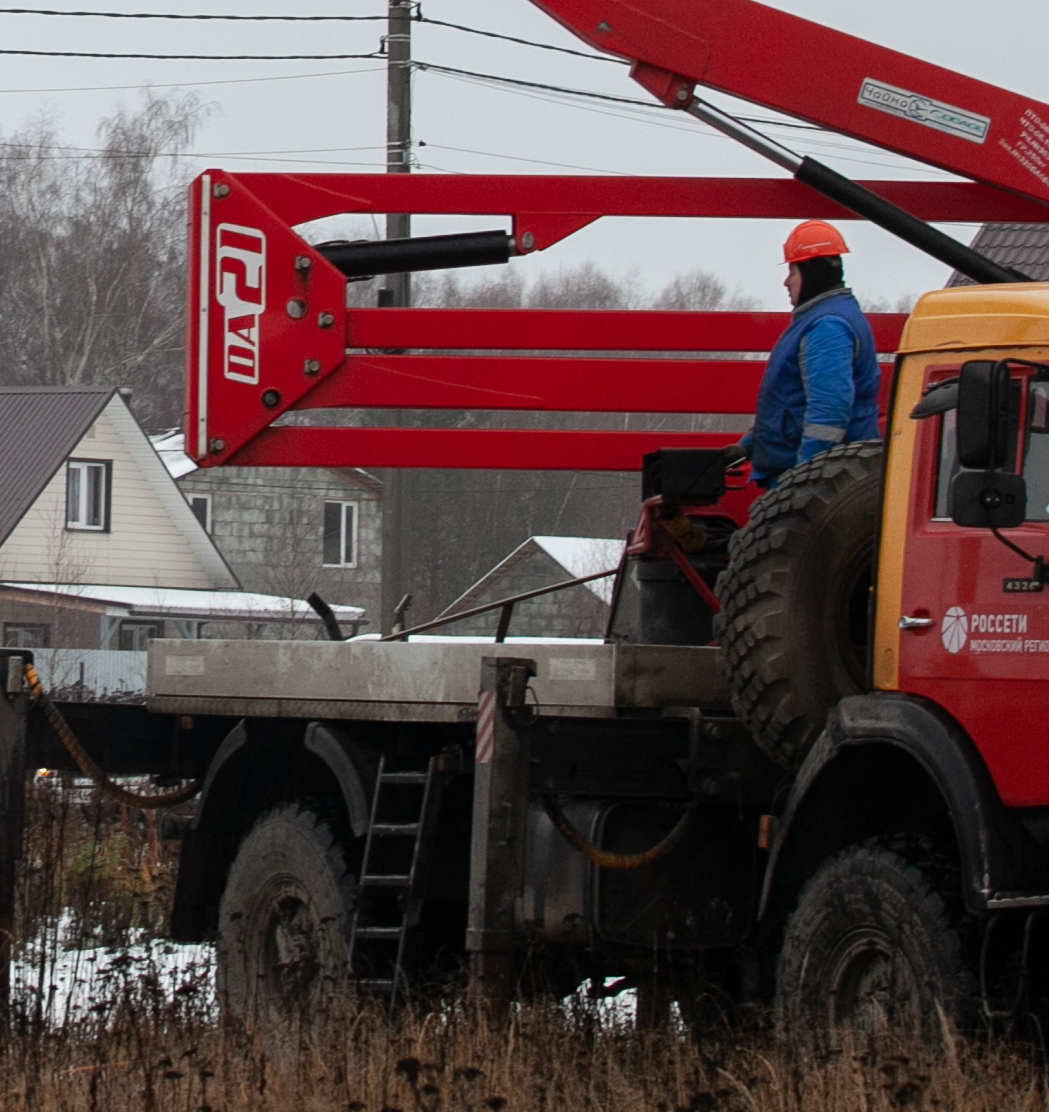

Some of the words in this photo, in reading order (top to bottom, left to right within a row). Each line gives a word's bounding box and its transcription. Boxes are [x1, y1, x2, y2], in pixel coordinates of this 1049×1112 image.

[864, 86, 909, 108] Чайка
[217, 223, 266, 385] DA21
[970, 614, 1028, 633] РОССЕТИ
[969, 637, 1023, 652] МОСКОВСКИЙ
